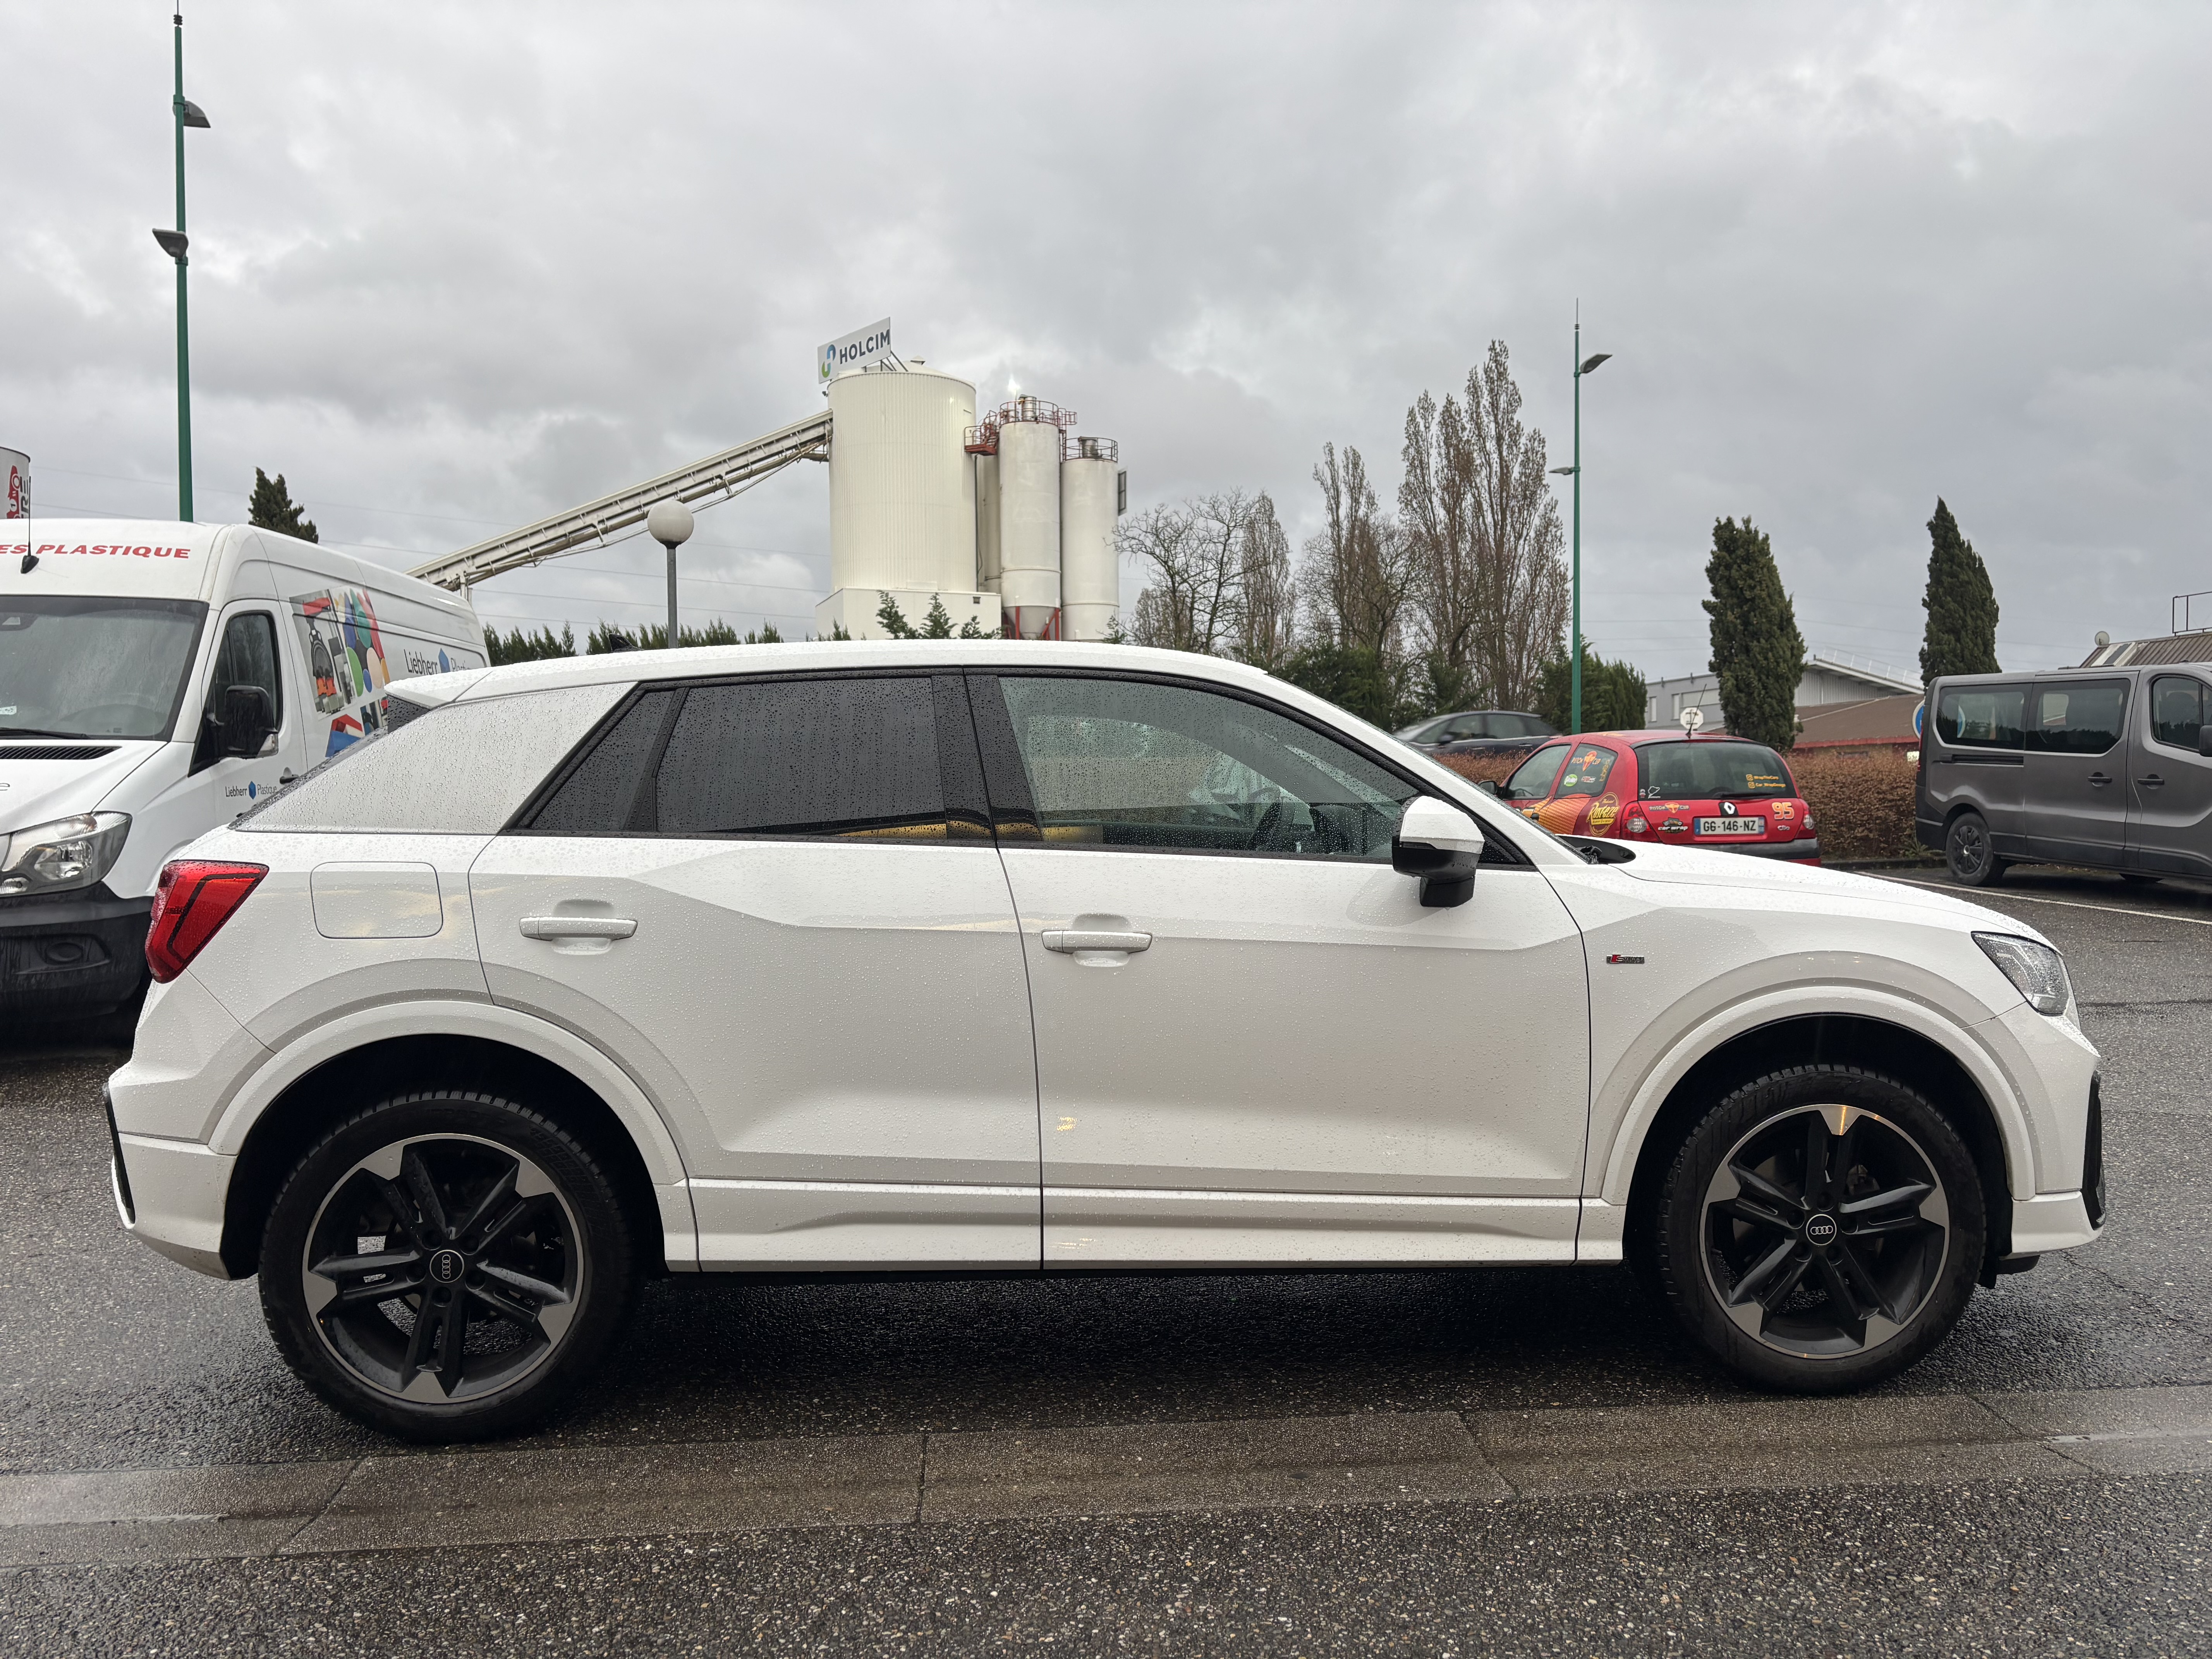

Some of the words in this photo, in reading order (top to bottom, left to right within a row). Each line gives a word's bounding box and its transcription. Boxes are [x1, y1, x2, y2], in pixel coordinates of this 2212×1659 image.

[840, 329, 890, 364] HOLCIM
[36, 544, 191, 558] PLASTIQUE
[404, 649, 438, 675] Liebherr
[225, 785, 247, 797] Liebherr
[257, 783, 277, 795] Plastique
[1772, 802, 1794, 820] 95
[1704, 820, 1756, 832] GG-146-NZ
